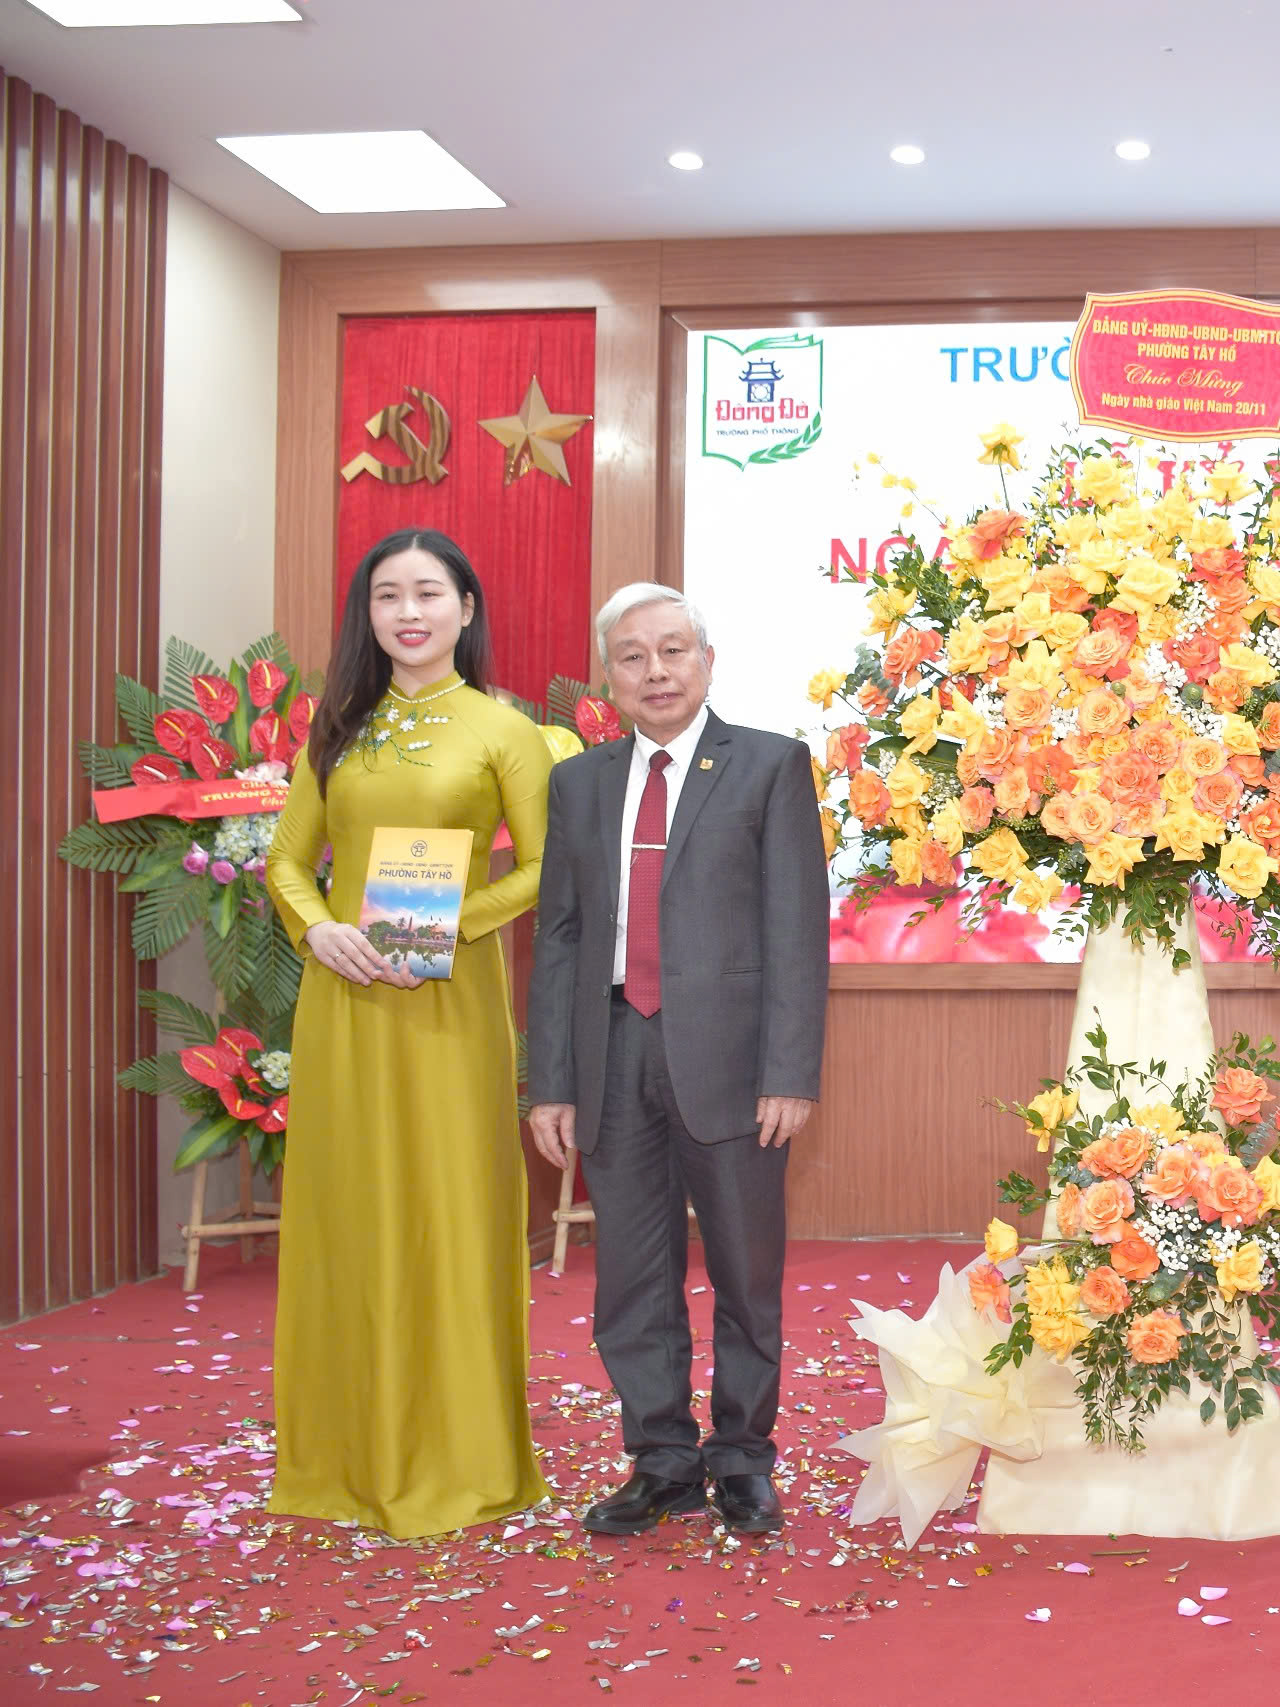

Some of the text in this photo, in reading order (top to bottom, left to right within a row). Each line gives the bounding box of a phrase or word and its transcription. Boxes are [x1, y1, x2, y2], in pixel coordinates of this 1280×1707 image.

[1092, 315, 1128, 336] ĐẢNG
[939, 336, 1072, 383] TRƯỜ
[1137, 341, 1190, 360] PHƯỜNG
[1193, 344, 1215, 361] TÂY
[1123, 363, 1245, 398] Chúc Mừng
[715, 399, 775, 423] Đông
[1101, 392, 1266, 416] Ngày nhà giáo Việt Nam 20/11
[378, 867, 419, 879] PHƯỜNG
[420, 868, 438, 879] TÂY
